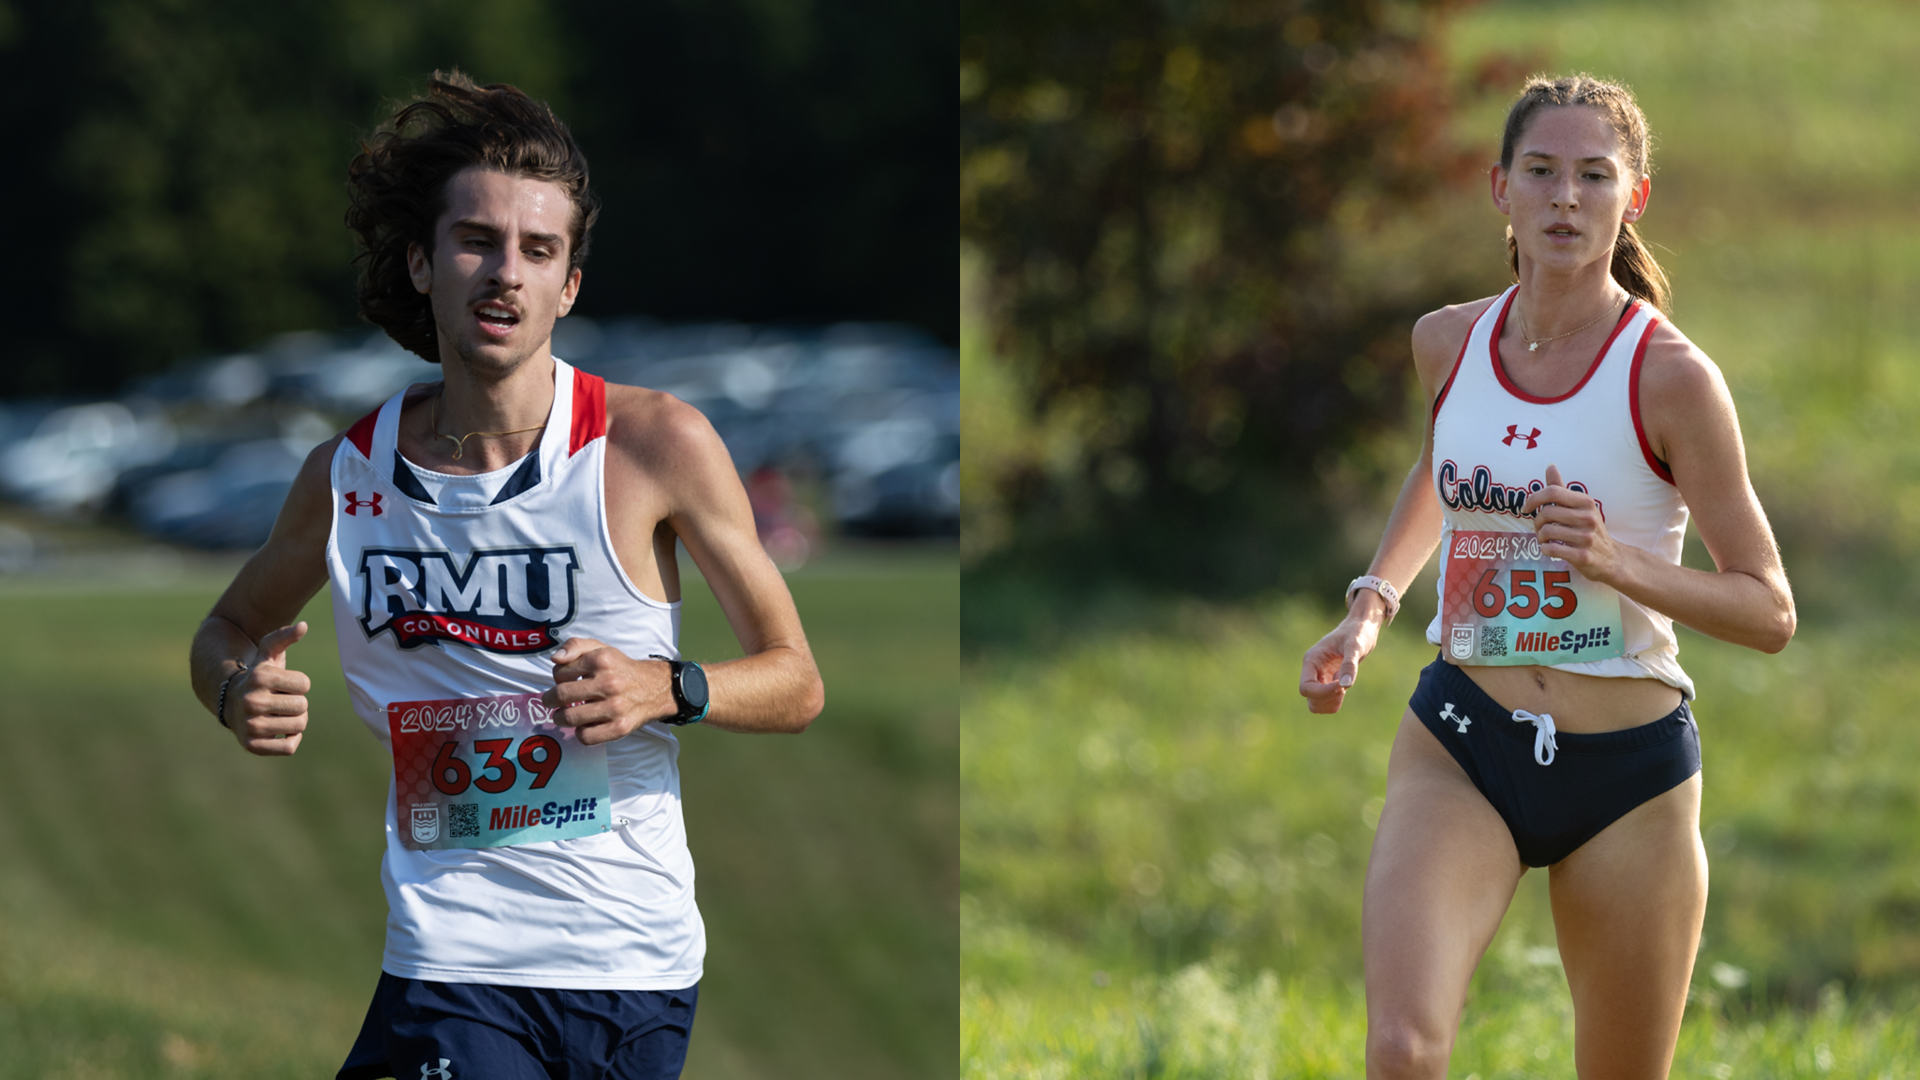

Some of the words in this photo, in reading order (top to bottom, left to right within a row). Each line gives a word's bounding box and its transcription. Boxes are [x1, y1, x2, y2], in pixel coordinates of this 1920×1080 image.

[1438, 459, 1605, 520] Colon
[1454, 535, 1510, 560] 2024
[361, 549, 577, 634] RMU
[1472, 568, 1578, 620] 655
[402, 618, 542, 647] COLONIALS
[1514, 626, 1612, 654] MileSplit
[400, 704, 473, 733] 2024
[476, 699, 521, 729] XC
[430, 734, 563, 796] 639
[488, 797, 598, 831] MileSplit
